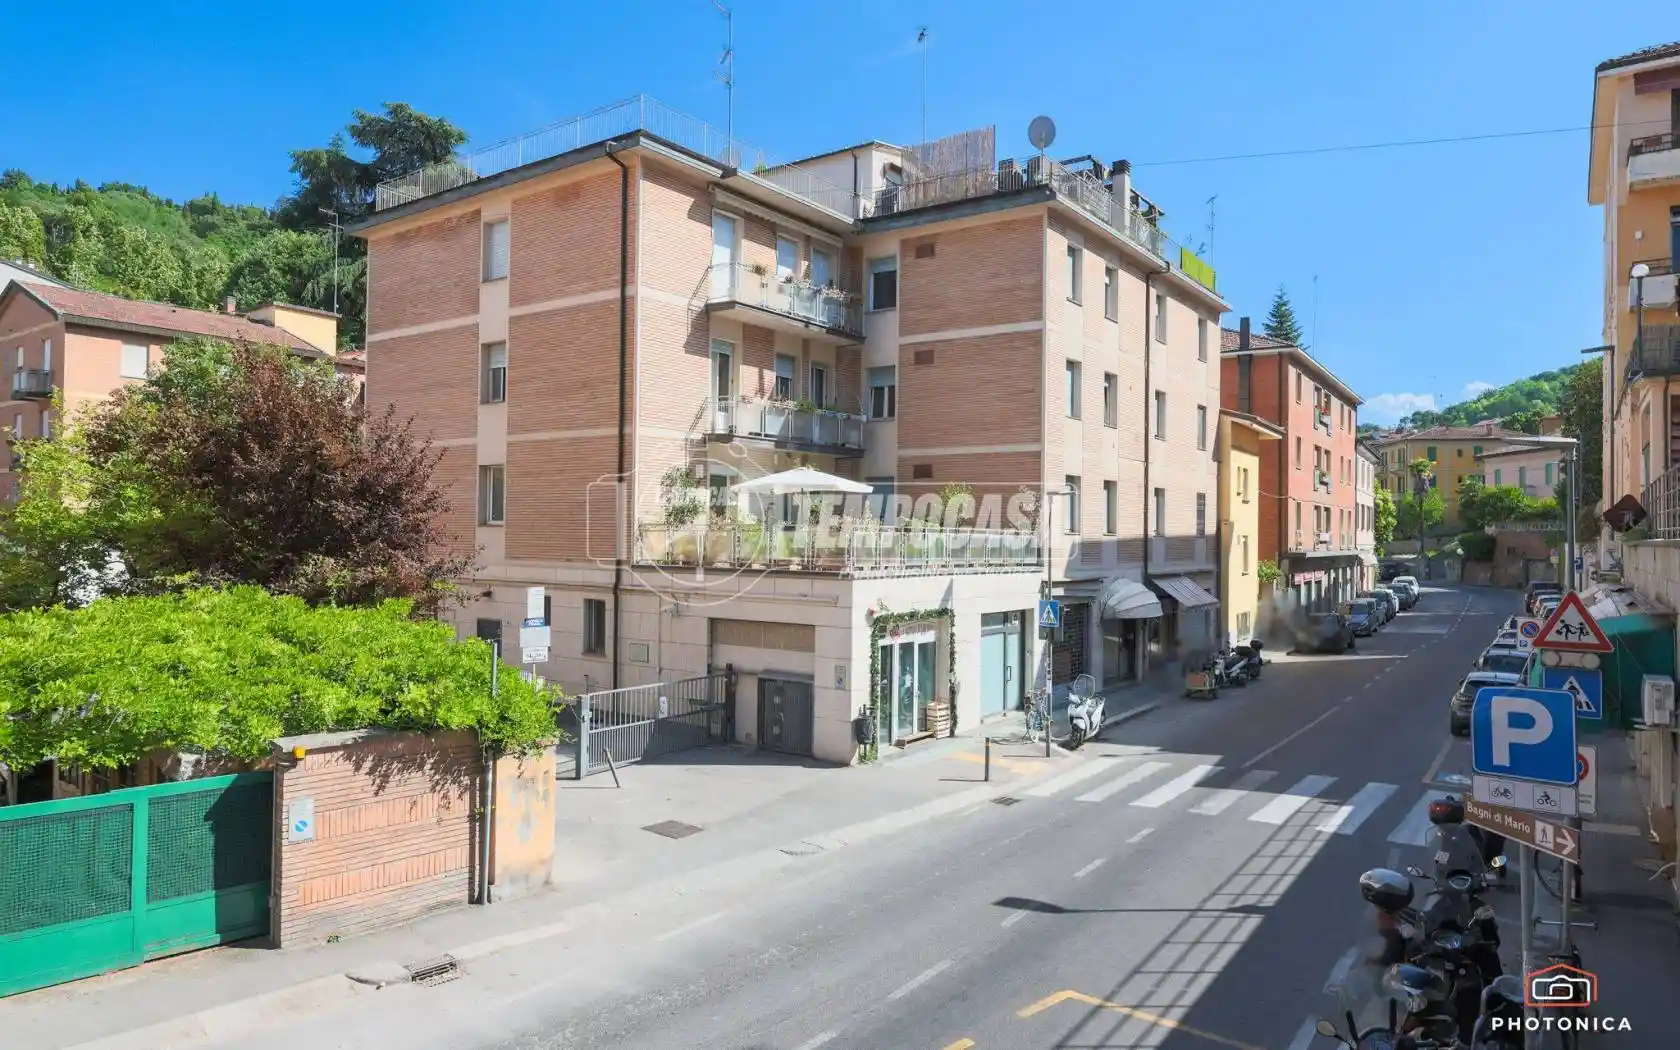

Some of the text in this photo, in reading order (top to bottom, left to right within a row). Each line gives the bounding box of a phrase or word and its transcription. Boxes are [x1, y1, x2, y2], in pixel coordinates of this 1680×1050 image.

[1491, 696, 1553, 767] P
[1466, 801, 1531, 834] Bagni di Mario
